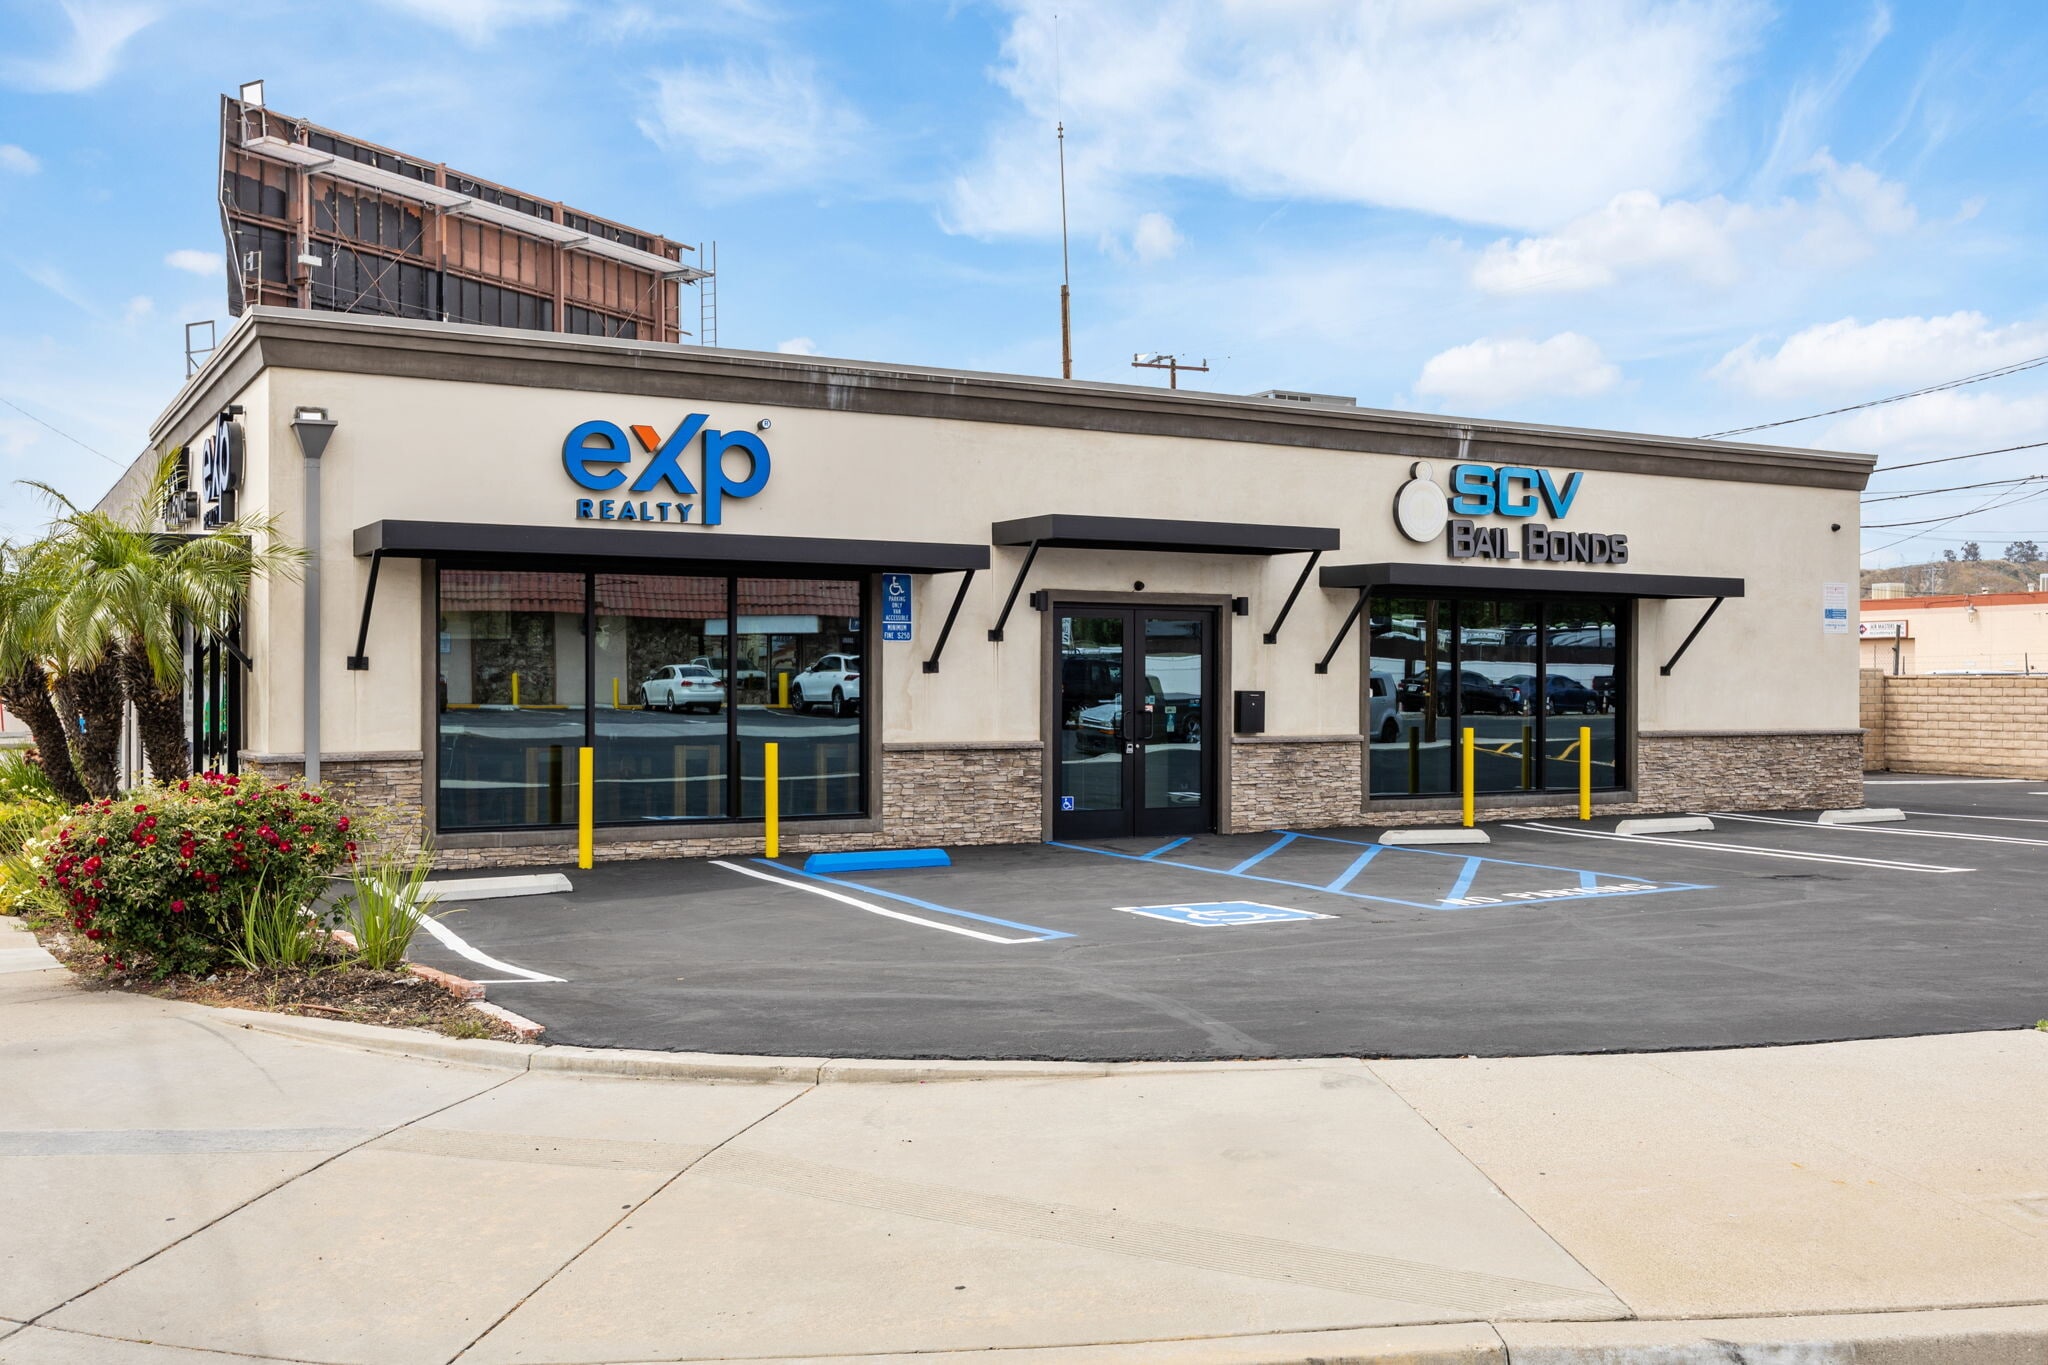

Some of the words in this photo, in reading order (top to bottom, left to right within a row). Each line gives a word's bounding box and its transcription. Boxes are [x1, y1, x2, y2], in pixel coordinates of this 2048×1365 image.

[1448, 464, 1584, 519] SCV
[576, 498, 693, 523] REALTY
[884, 631, 894, 639] FINE
[1435, 896, 1503, 906] NO
[1502, 883, 1658, 899] PARKING
